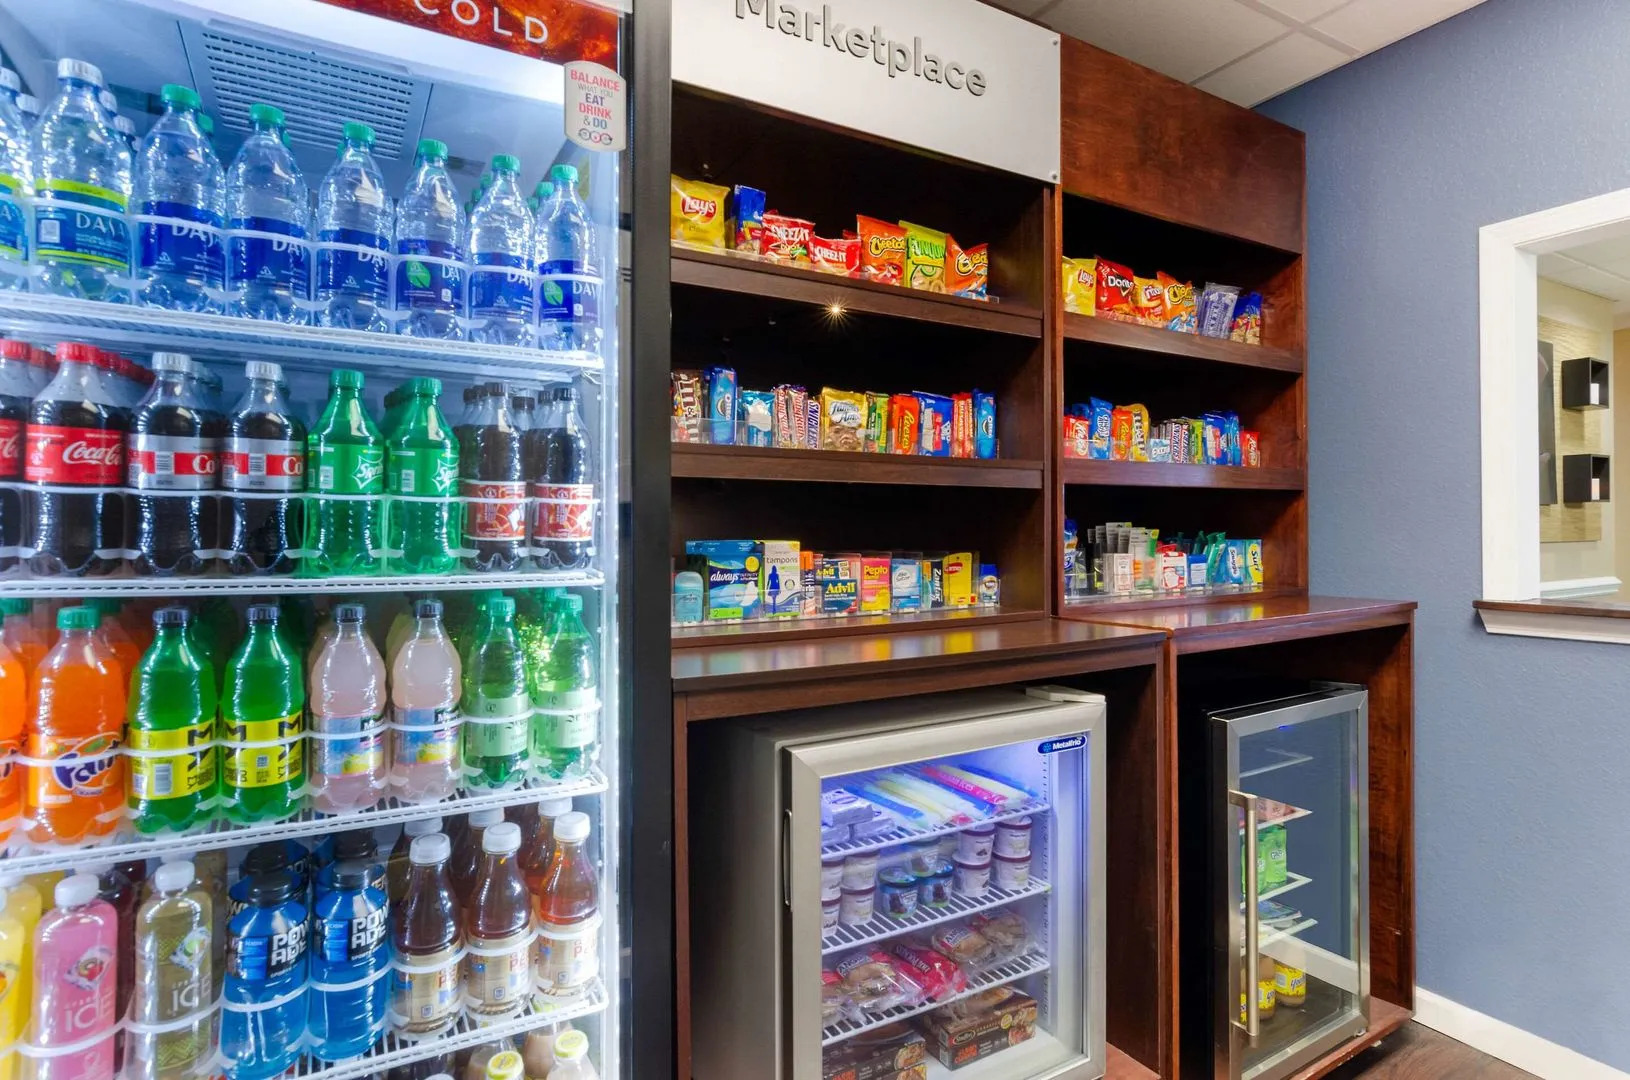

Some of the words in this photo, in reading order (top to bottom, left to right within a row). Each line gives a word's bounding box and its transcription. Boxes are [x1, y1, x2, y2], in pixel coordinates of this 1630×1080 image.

[414, 0, 548, 43] COLD
[735, 0, 987, 97] Marketplace
[570, 69, 620, 92] BALANCE
[577, 82, 598, 94] WHAT
[600, 88, 614, 98] YOU
[585, 92, 605, 106] EAT
[579, 101, 612, 120] DRINK
[583, 115, 591, 127] &
[593, 117, 608, 130] DO
[766, 556, 798, 565] tampons
[710, 571, 738, 584] always
[864, 565, 888, 575] Pepto
[826, 581, 856, 594] Advil
